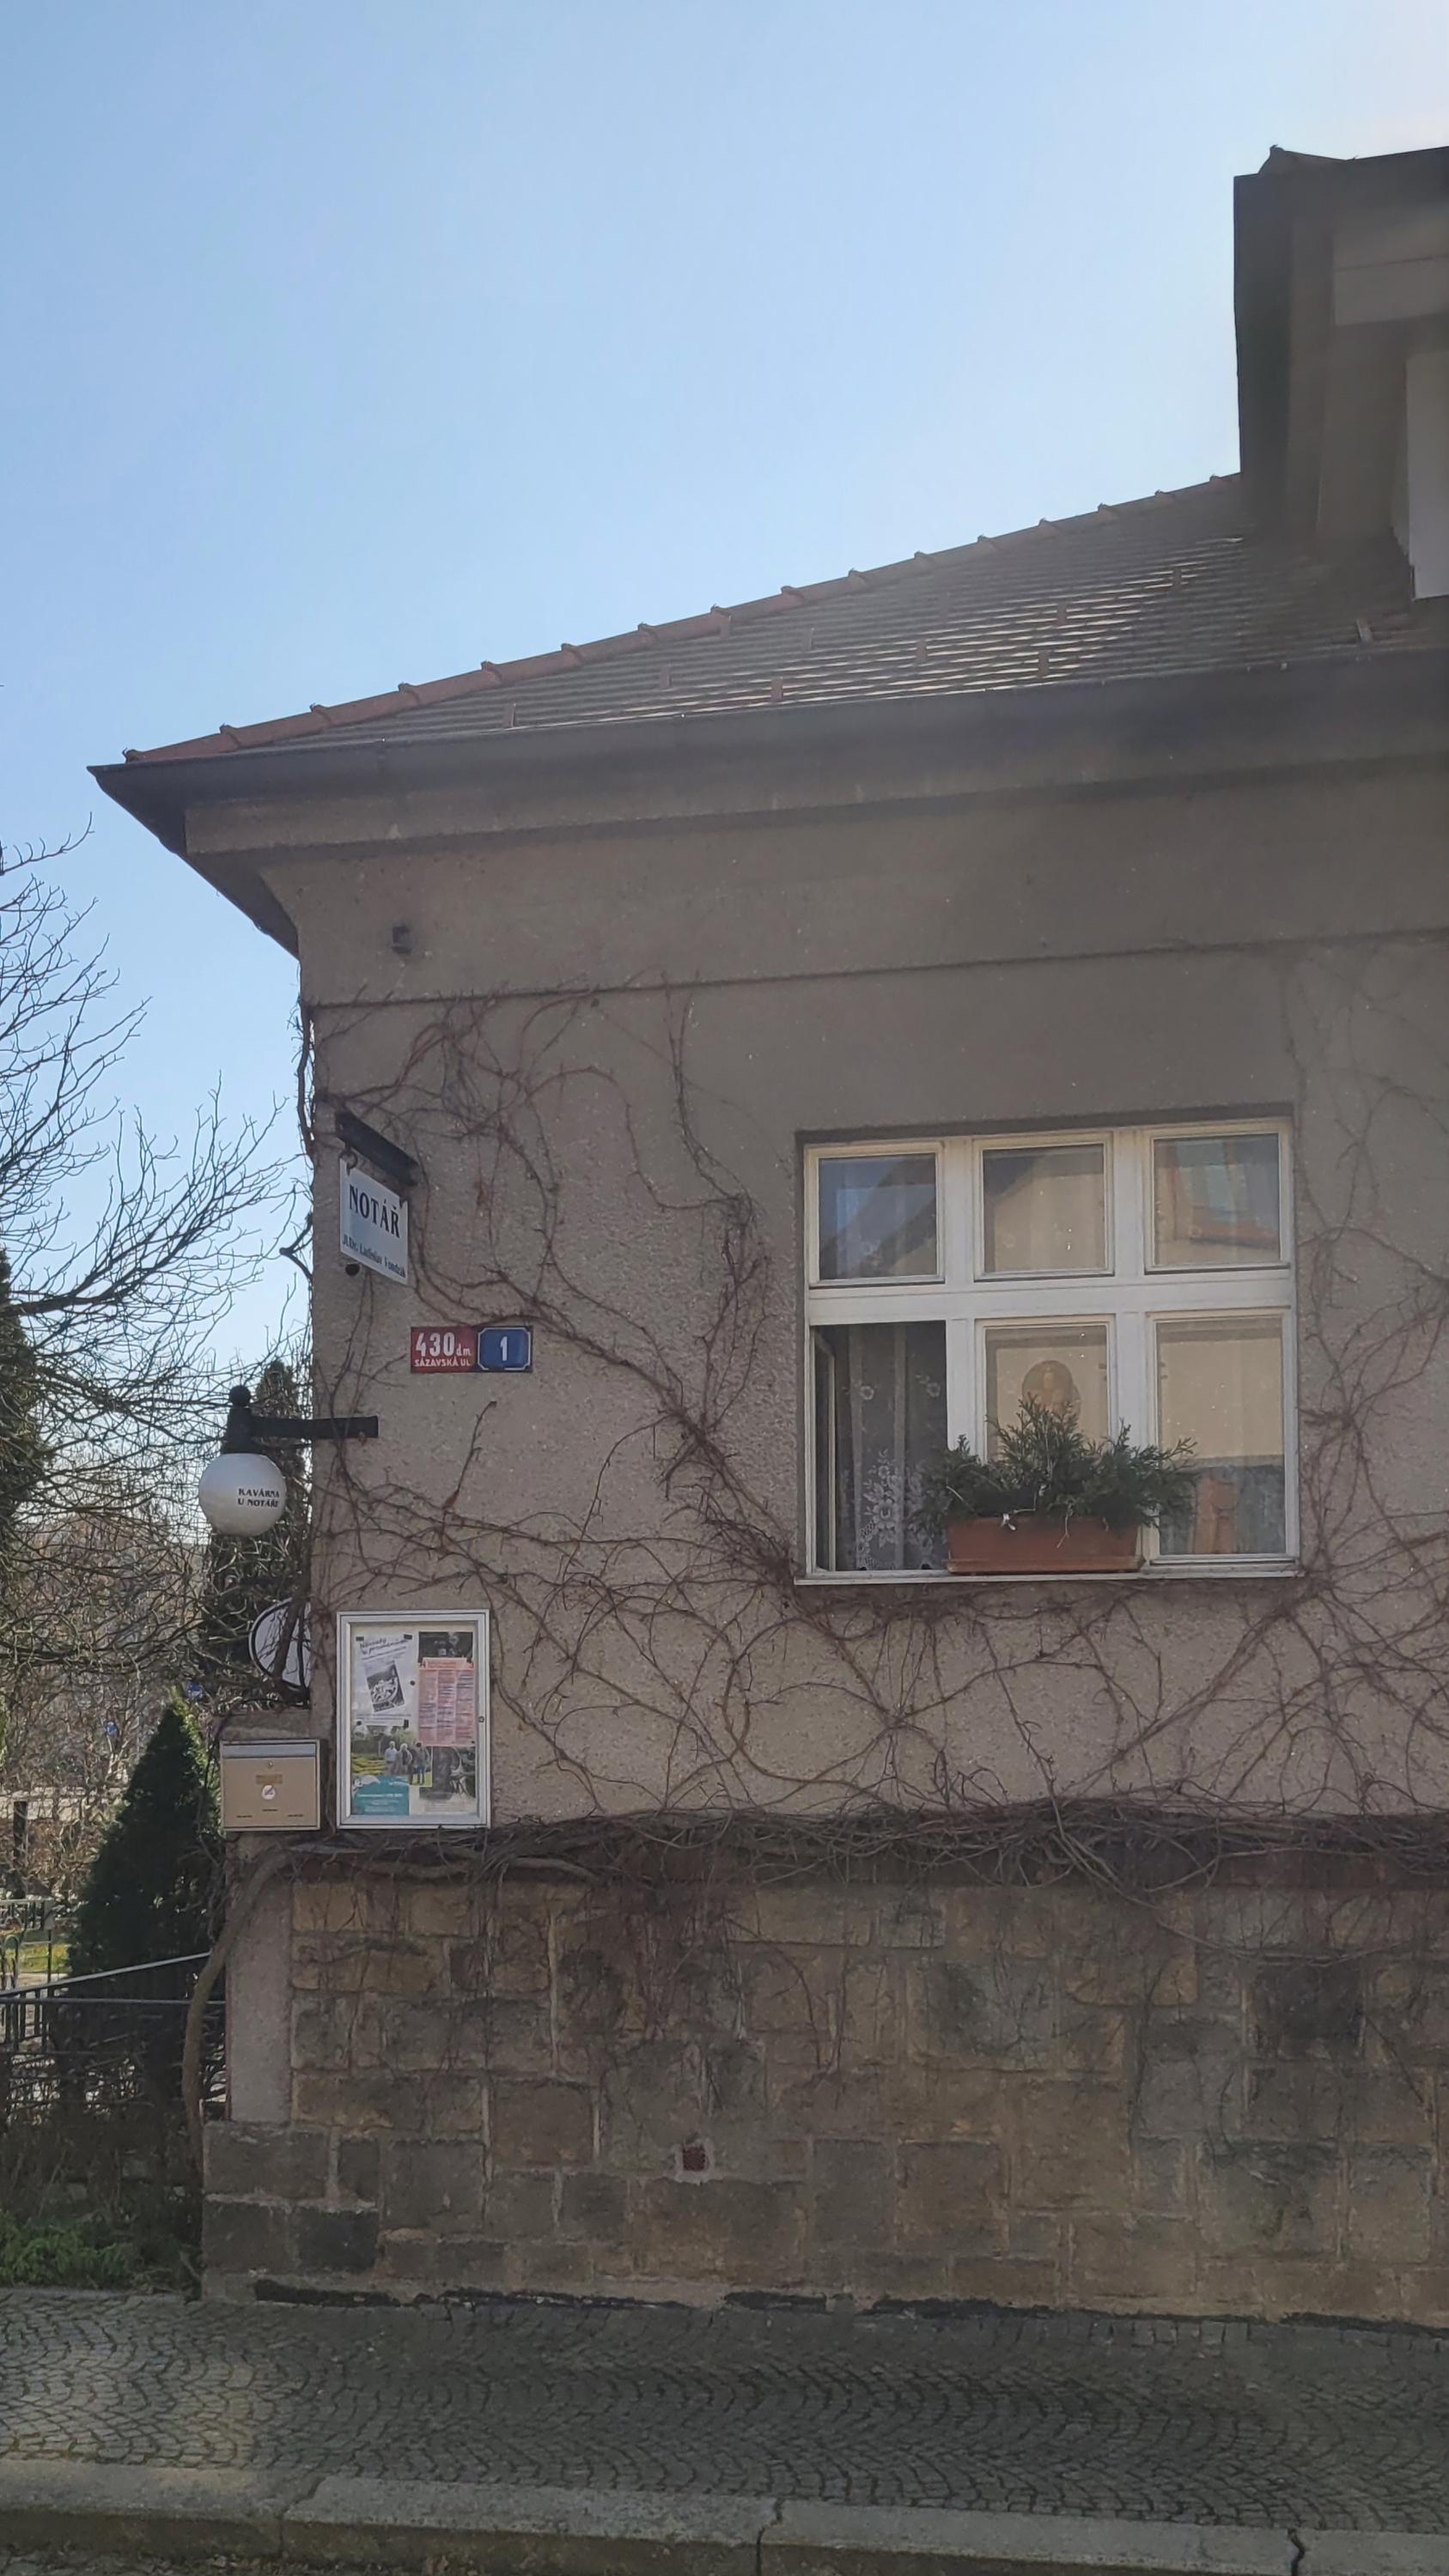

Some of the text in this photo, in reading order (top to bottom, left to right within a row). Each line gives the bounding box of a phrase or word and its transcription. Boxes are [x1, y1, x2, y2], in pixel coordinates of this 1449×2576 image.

[349, 1184, 399, 1238] NOTÁŘ
[416, 1332, 455, 1357] 430
[500, 1336, 508, 1362] 1
[414, 1356, 459, 1367] SÁZAVSKÁ
[238, 1487, 280, 1498] KAVÁRNA
